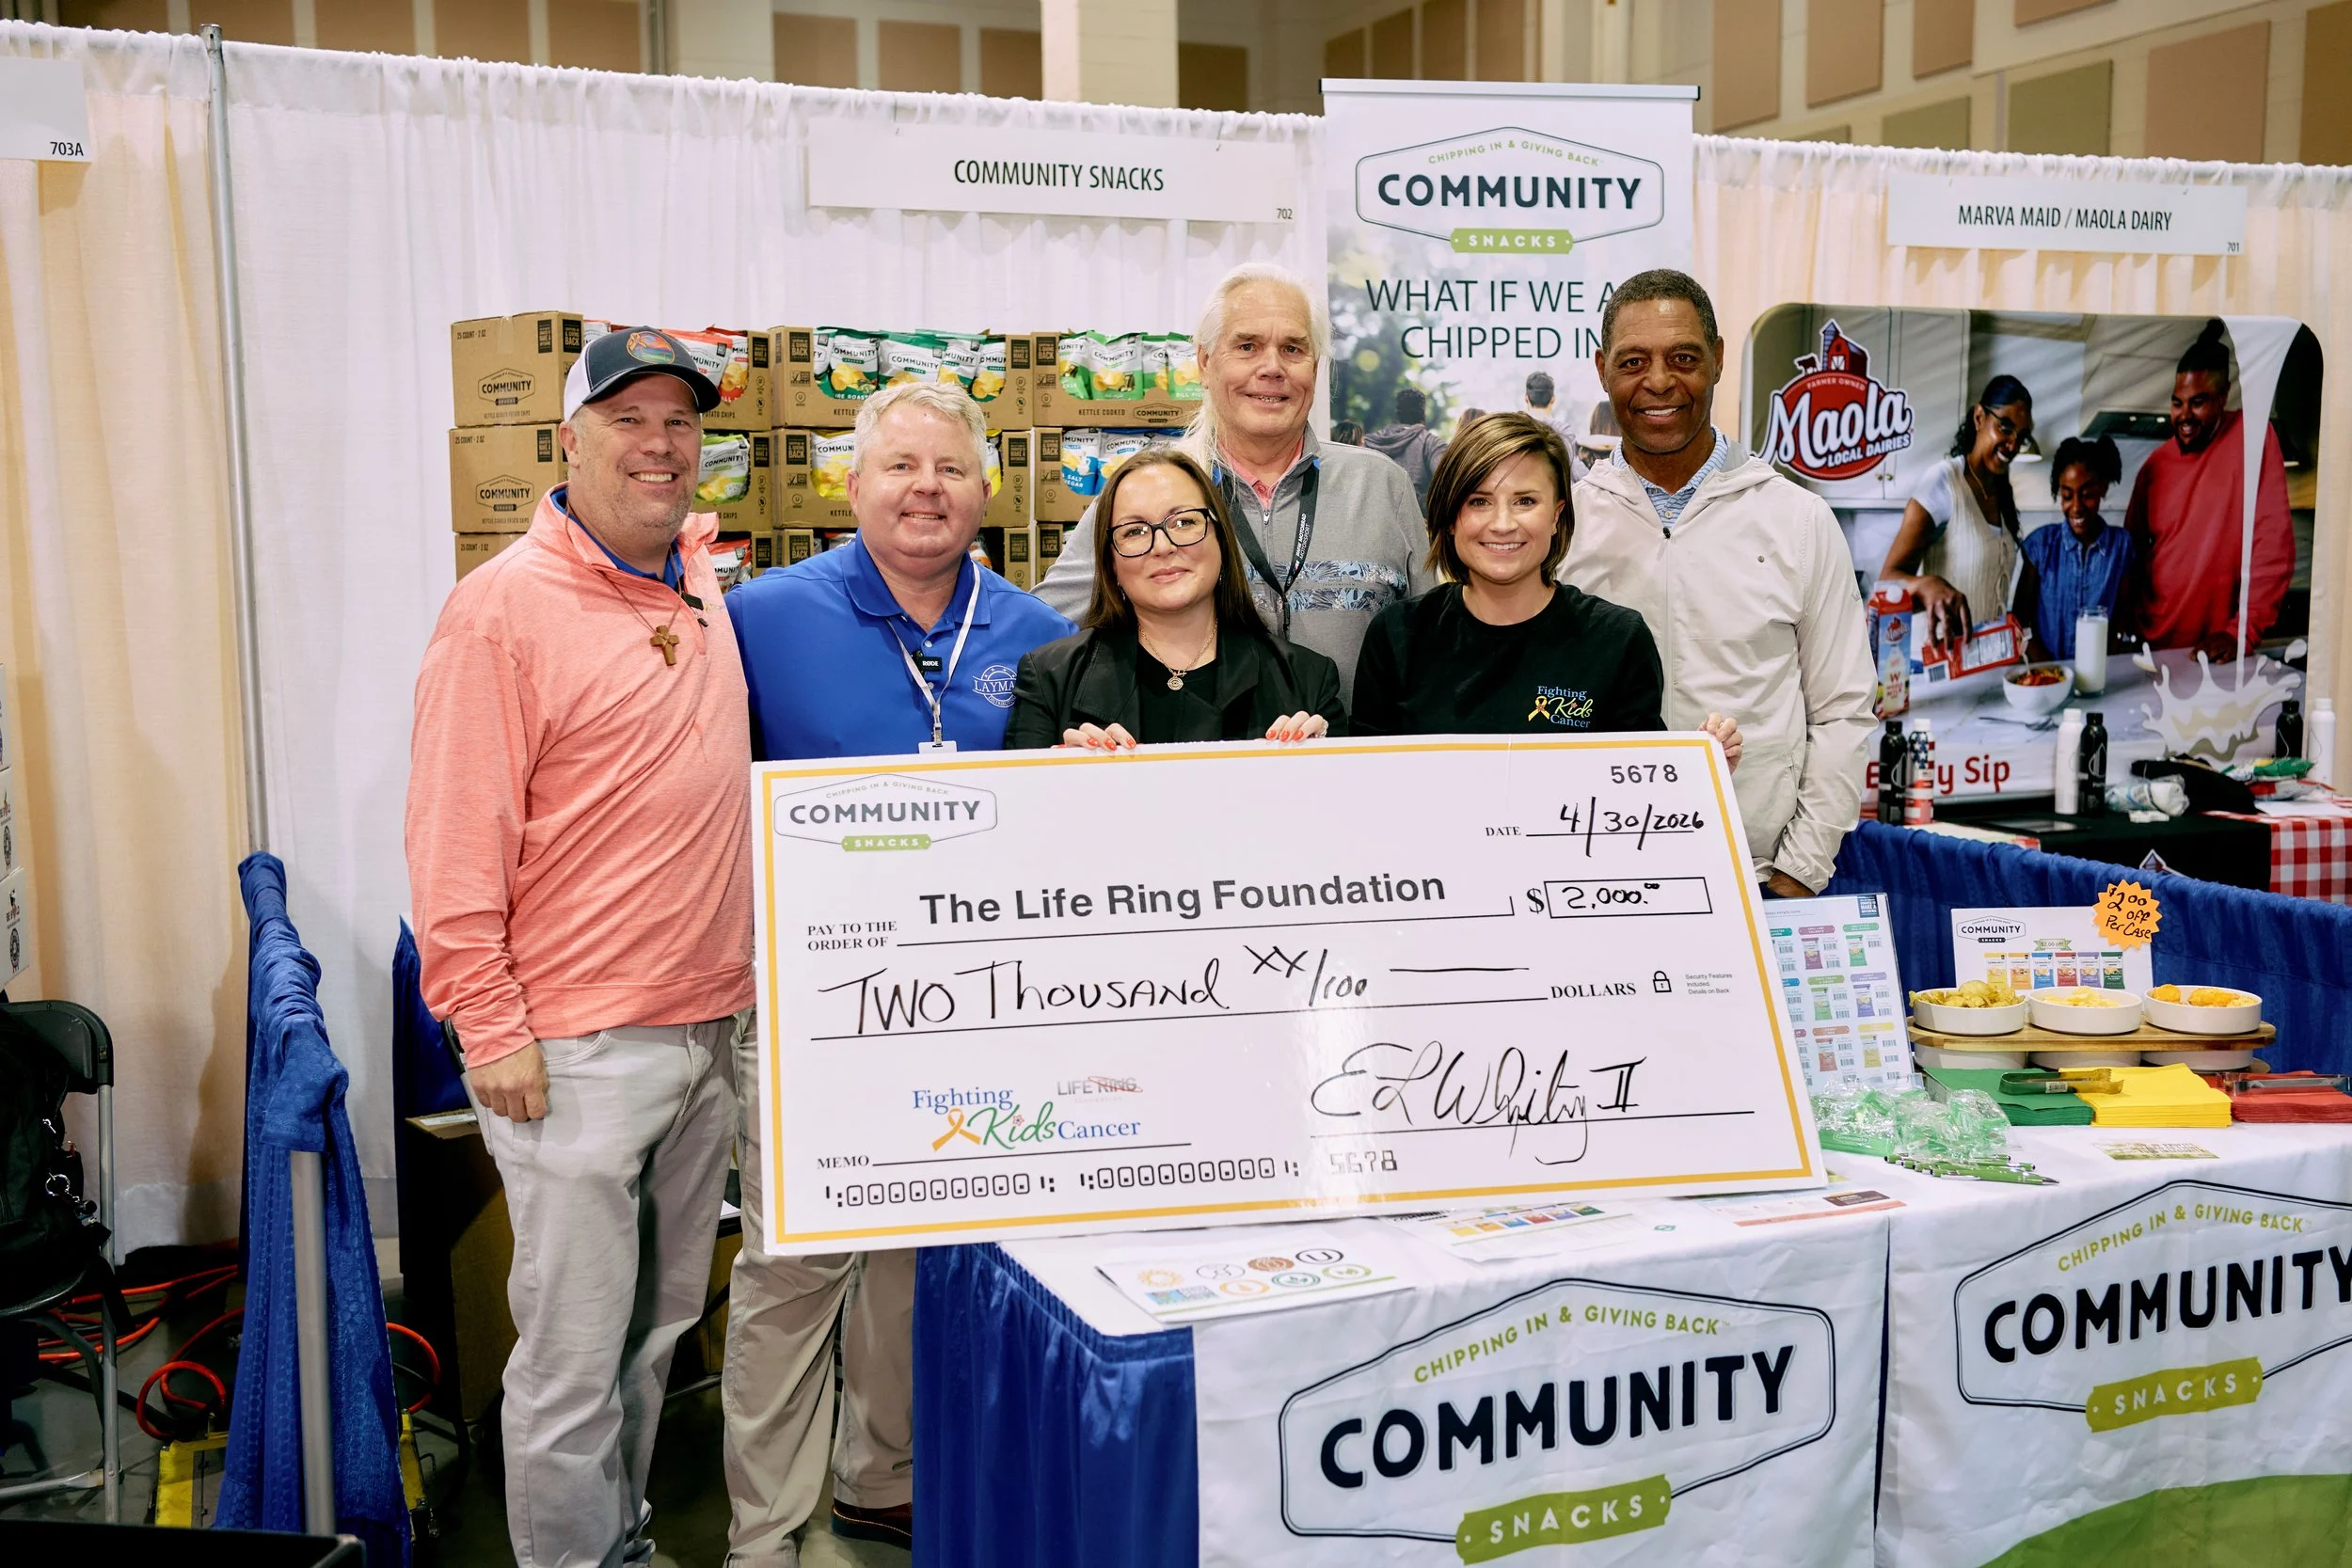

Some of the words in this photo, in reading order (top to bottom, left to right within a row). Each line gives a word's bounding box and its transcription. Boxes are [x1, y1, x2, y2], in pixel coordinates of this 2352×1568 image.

[50, 141, 84, 157] 703A
[1428, 147, 1486, 165] CHIPPING
[1489, 142, 1502, 150] IN
[1508, 140, 1516, 149] &
[1521, 141, 1563, 158] GIVING
[954, 159, 1083, 188] COMMUNITY
[1089, 165, 1165, 192] SNACKS
[1378, 173, 1641, 210] COMMUNITY
[1277, 208, 1294, 220] 702
[1959, 205, 2015, 227] MARVA
[2021, 207, 2061, 229] MAID
[2075, 208, 2126, 230] MAOLA
[2131, 211, 2172, 232] DAIRY
[1469, 234, 1556, 248] SNACKS
[2227, 242, 2240, 253] 701
[1366, 279, 1478, 311] WHAT
[1489, 280, 1518, 312] IF
[1529, 281, 1584, 312] WE
[1401, 326, 1562, 359] CHIPPED
[691, 356, 720, 369] MUNITY
[892, 356, 939, 370] COMMUNITY
[945, 353, 975, 364] MUNITY
[1094, 350, 1134, 361] COMMUNITY
[482, 380, 532, 394] COMMUNITY
[1760, 381, 1913, 469] Maola
[788, 451, 805, 459] BACK
[818, 445, 855, 453] COMMUNI
[1828, 449, 1864, 467] LOCAL
[1867, 436, 1911, 457] DAIRIES
[705, 454, 744, 467] COMMUNITY
[480, 488, 530, 499] COMMUNITY
[974, 679, 1015, 693] LAYMA
[1536, 685, 1587, 701] Fighting
[1548, 696, 1594, 719] Kids
[1550, 714, 1591, 728] Cancer
[1610, 764, 1679, 784] 5678
[1964, 753, 2010, 794] Sip
[826, 785, 867, 799] CHIPPING
[893, 782, 923, 792] GIVING
[926, 786, 949, 796] BACK
[789, 800, 980, 825] COMMUNITY
[1486, 825, 1521, 837] DATE
[854, 838, 919, 847] SNACKS
[919, 894, 1001, 925] The
[1015, 887, 1093, 921] Life
[1107, 880, 1202, 920] Ring
[1213, 873, 1445, 910] Foundation
[1528, 888, 1545, 914] $
[807, 925, 836, 937] PAY
[839, 923, 862, 935] TO
[866, 921, 898, 933] THE
[1962, 926, 2020, 934] COMMUNITY
[807, 939, 863, 952] ORDER
[867, 937, 889, 949] OF
[1550, 981, 1636, 999] DOLLARS
[1057, 1080, 1093, 1095] LIFE
[912, 1085, 1014, 1117] Fighting
[966, 1101, 1057, 1149] Kids
[1057, 1117, 1141, 1142] Cancer
[817, 1155, 870, 1169] MEMO
[1330, 1149, 1398, 1176] 5678
[2058, 1222, 2144, 1273] CHIPPING
[2150, 1211, 2167, 1230] IN
[2173, 1204, 2186, 1220] &
[2195, 1203, 2253, 1226] GIVING
[1984, 1244, 2352, 1364] COMMUNITY
[1414, 1326, 1518, 1384] CHIPPING
[1526, 1313, 1549, 1335] IN
[1560, 1306, 1572, 1323] &
[1585, 1305, 1658, 1330] GIVING
[2114, 1372, 2237, 1416] SNACKS
[1320, 1345, 1795, 1489] COMMUNITY
[1490, 1495, 1644, 1544] SNACKS
